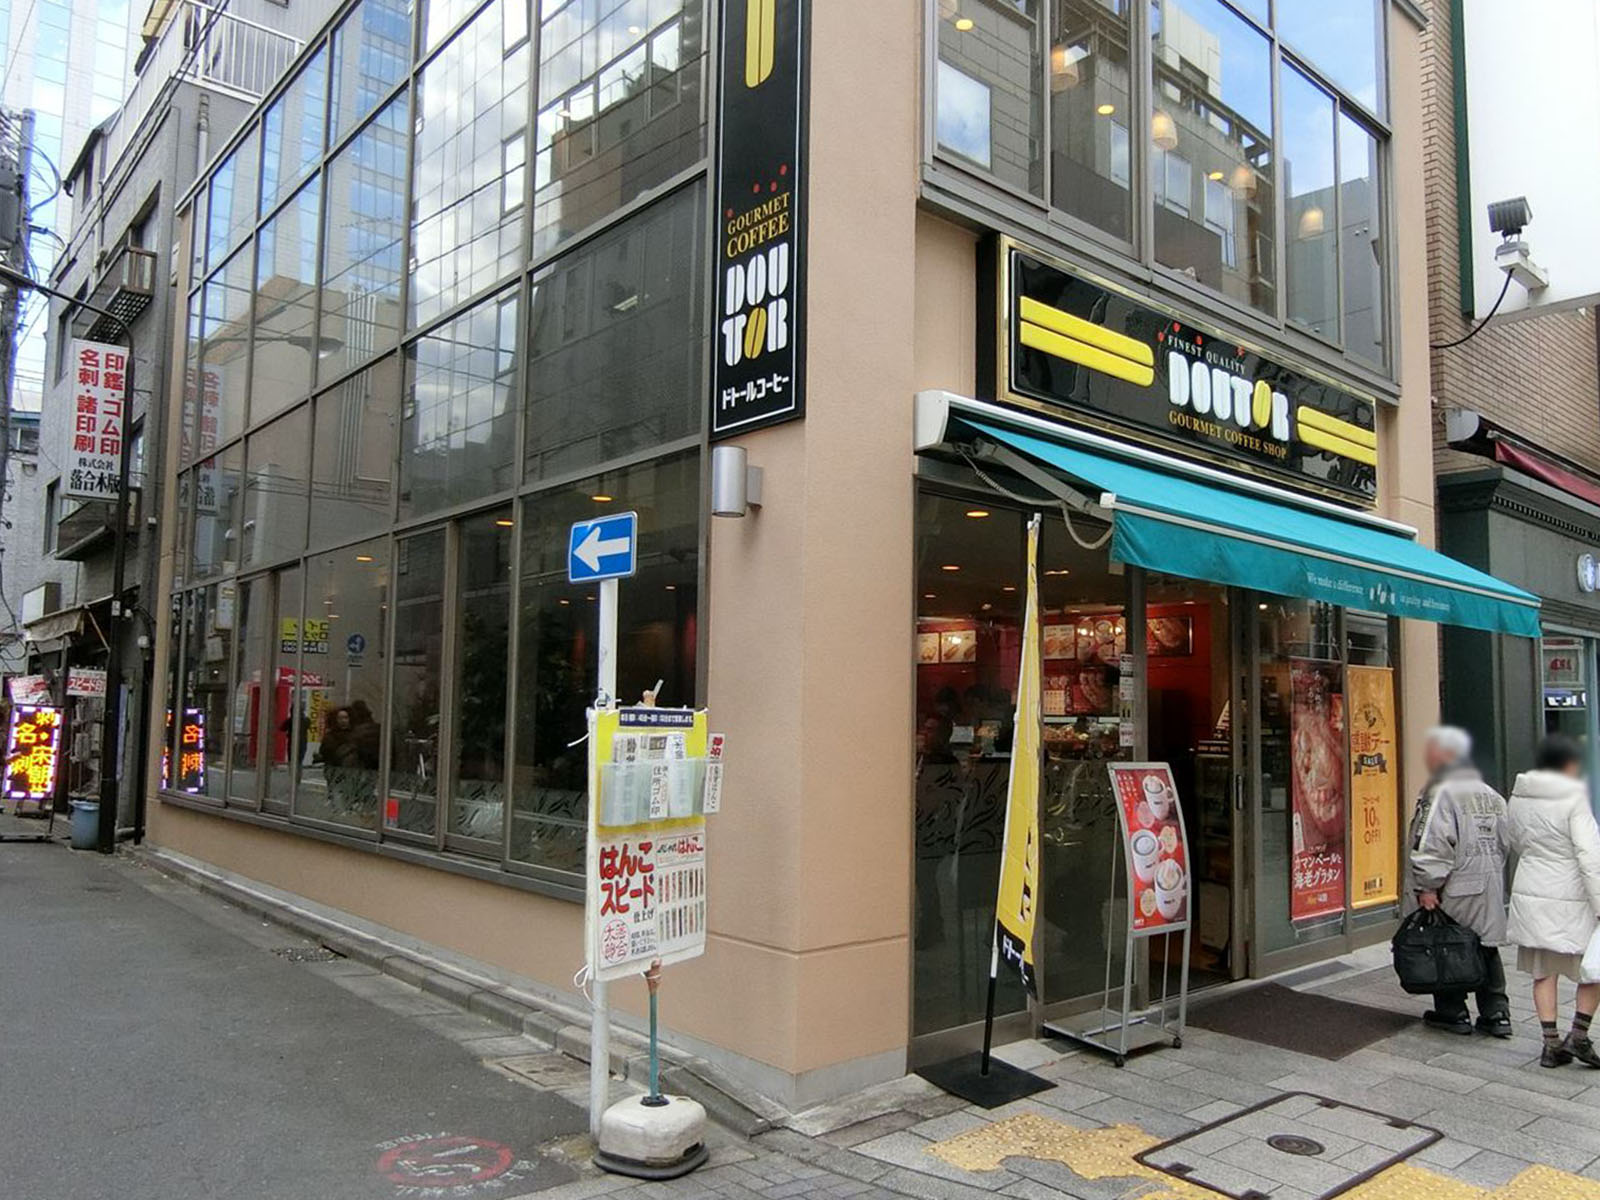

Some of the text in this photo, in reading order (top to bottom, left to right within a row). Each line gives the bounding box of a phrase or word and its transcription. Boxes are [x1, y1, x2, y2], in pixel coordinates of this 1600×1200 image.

[726, 212, 789, 258] COFFEE
[727, 192, 790, 235] GOURMET
[1168, 335, 1246, 375] FINEST QUALITY
[74, 348, 100, 453] 名刺・諸印刷
[722, 373, 789, 410] ドトールコーヒー
[1169, 351, 1290, 441] DOUTOR
[1169, 410, 1287, 459] GOURMET COFFEE SHOP
[600, 842, 654, 880] はんこ
[600, 873, 655, 916] スピード
